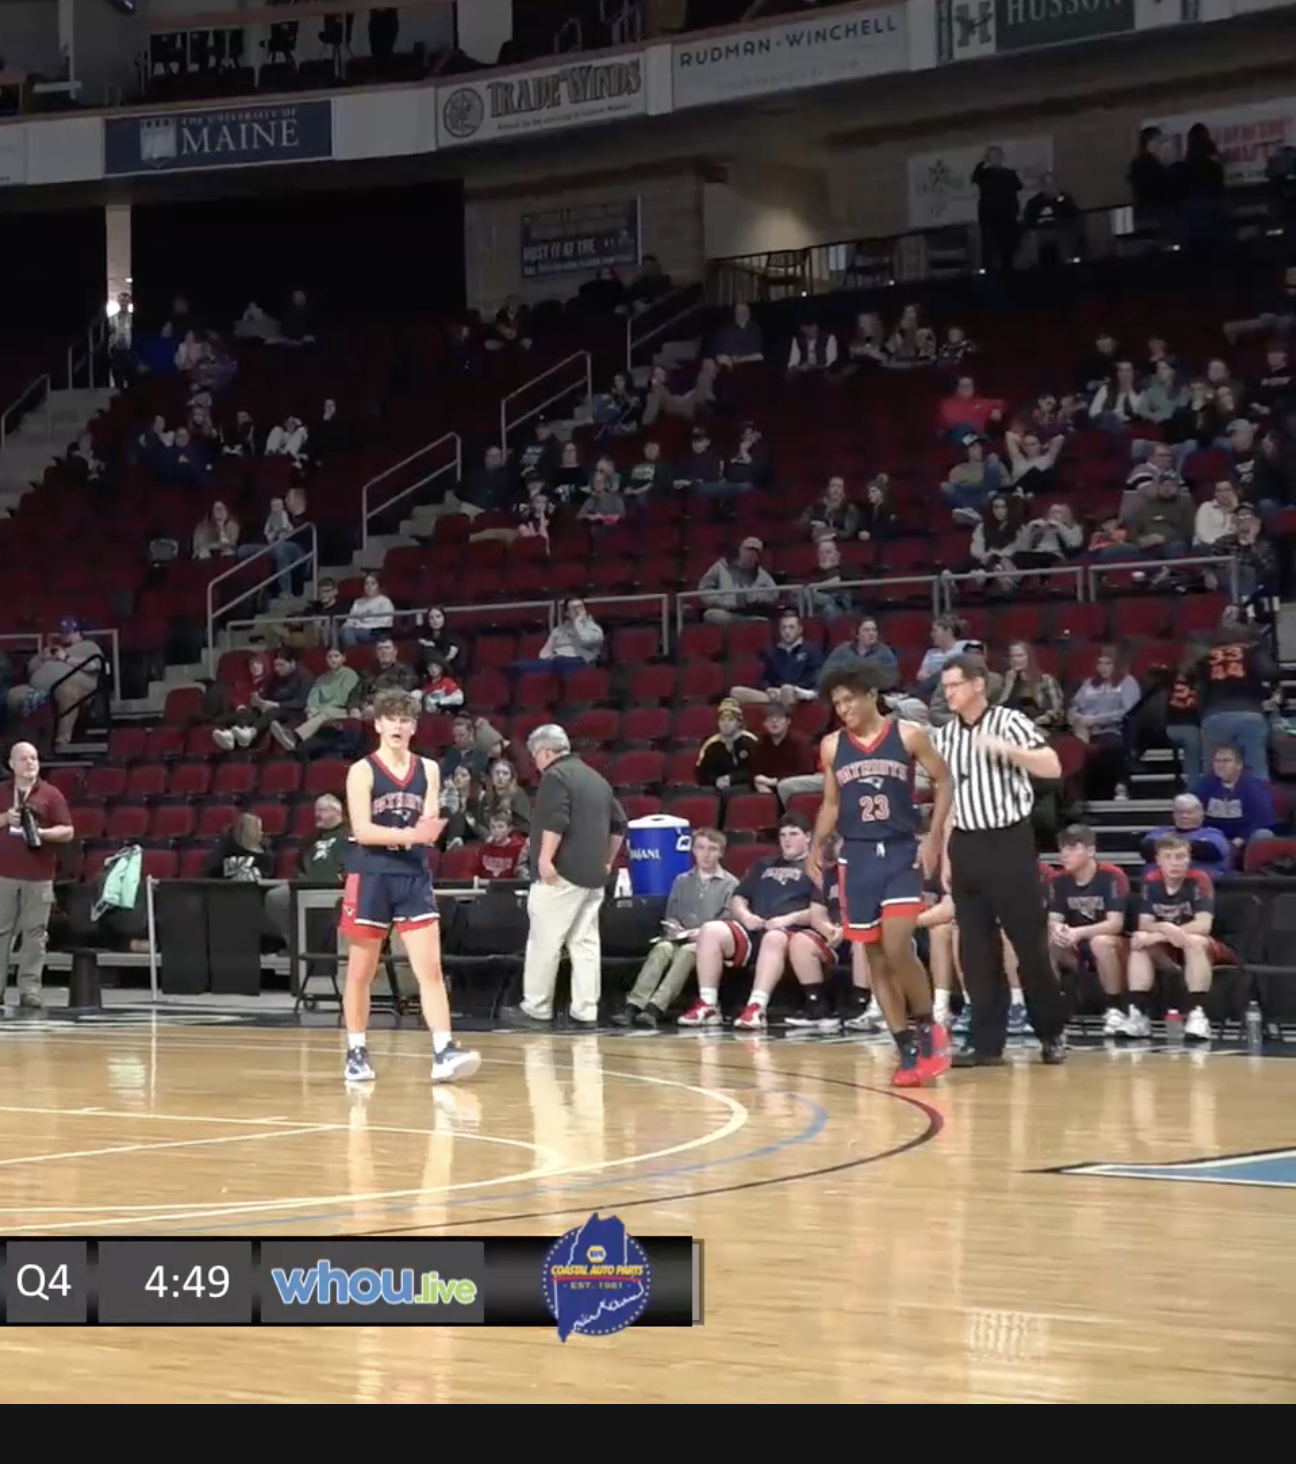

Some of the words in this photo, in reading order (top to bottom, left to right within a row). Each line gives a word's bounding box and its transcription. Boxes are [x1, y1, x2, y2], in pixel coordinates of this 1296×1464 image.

[1006, 0, 1124, 26] HUSSO
[680, 38, 771, 68] RUDMAN
[785, 16, 897, 48] WINCHELL
[180, 119, 299, 155] MAINE
[859, 794, 891, 822] 23
